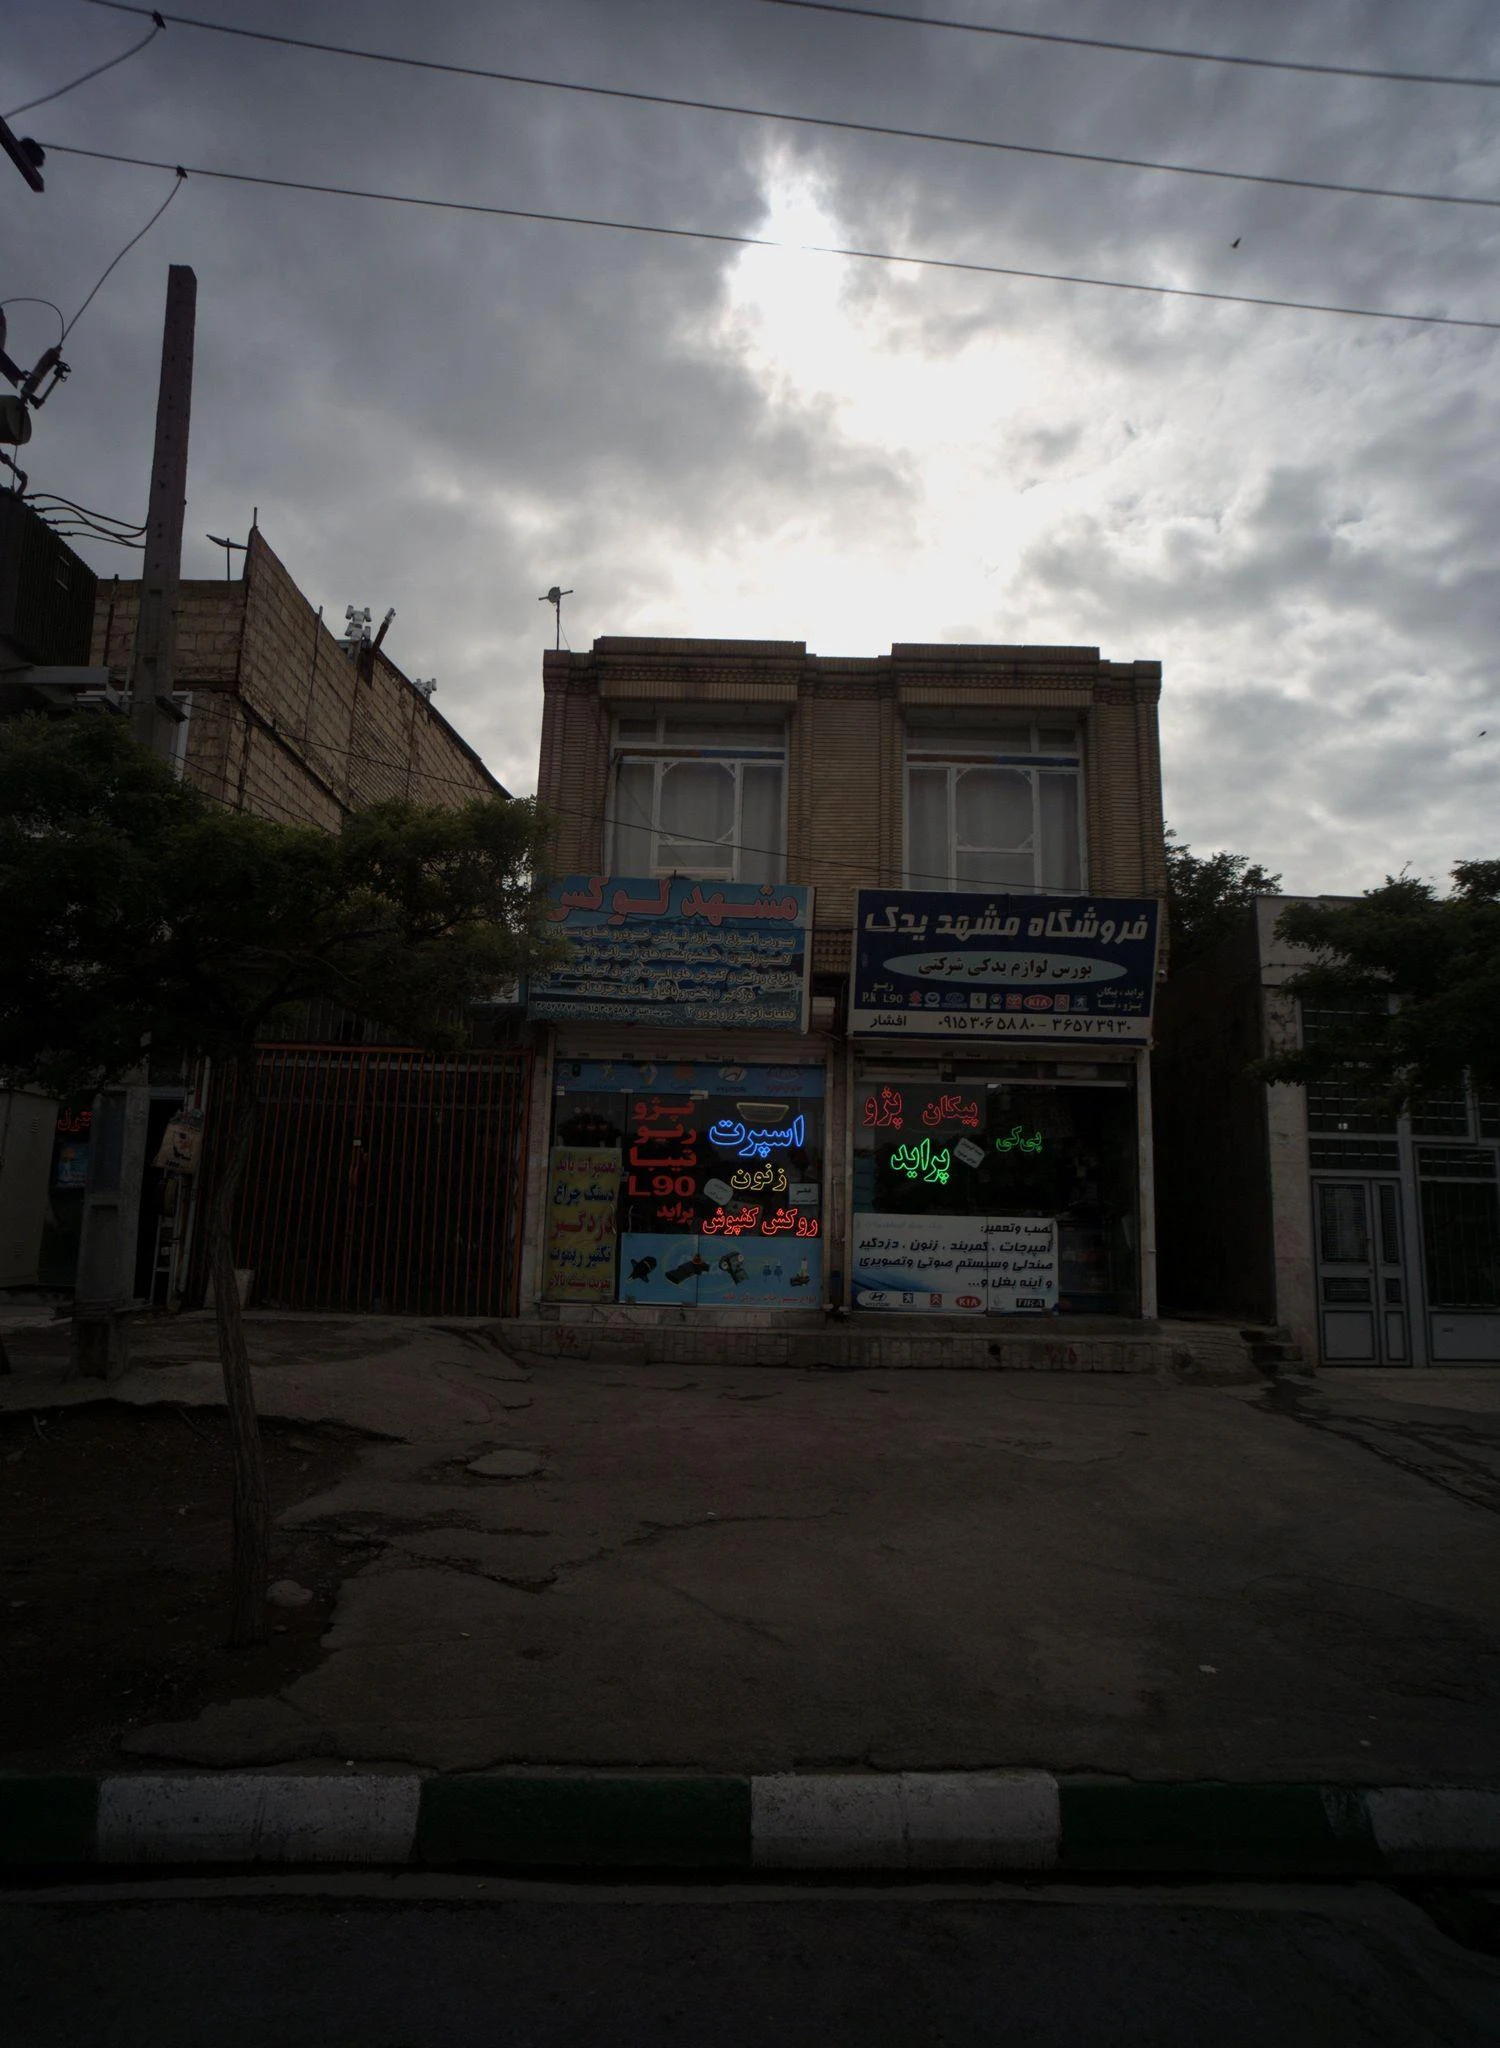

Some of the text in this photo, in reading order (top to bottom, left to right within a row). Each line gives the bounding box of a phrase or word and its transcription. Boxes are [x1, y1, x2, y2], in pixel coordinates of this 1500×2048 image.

[543, 876, 799, 927] مشهد لوکس
[865, 903, 1149, 945] فروشگاه مشهد یدک
[612, 929, 651, 942] خودرو
[691, 931, 723, 946] لوازم
[725, 932, 759, 948] انواع
[918, 956, 1092, 980] بورس لوازم یدکی شرکتی
[872, 981, 894, 993] ریو
[1096, 986, 1119, 999] پیکان
[883, 993, 903, 1005] L90
[869, 1014, 907, 1029] افشار
[939, 1015, 1035, 1031] ۰۹۱۵۳۰۶۵۸۸۰
[632, 1097, 696, 1122] پژو
[862, 1087, 979, 1130] پیکان پژو
[633, 1123, 697, 1145] ریو
[708, 1114, 805, 1159] اسپرت
[629, 1146, 697, 1172] تیبا
[890, 1137, 951, 1186] پراید
[730, 1163, 788, 1192] زنون
[628, 1174, 697, 1198] L90
[701, 1206, 819, 1237] روکش کفپوش
[859, 1238, 900, 1252] دزدگیر
[909, 1239, 939, 1252] زنون
[949, 1240, 989, 1254] کمربند
[917, 1257, 953, 1269] صوتی
[1012, 1259, 1053, 1272] صندلی
[991, 1276, 1017, 1290] بغل
[1045, 1279, 1053, 1289] و
[958, 1297, 981, 1307] KIA
